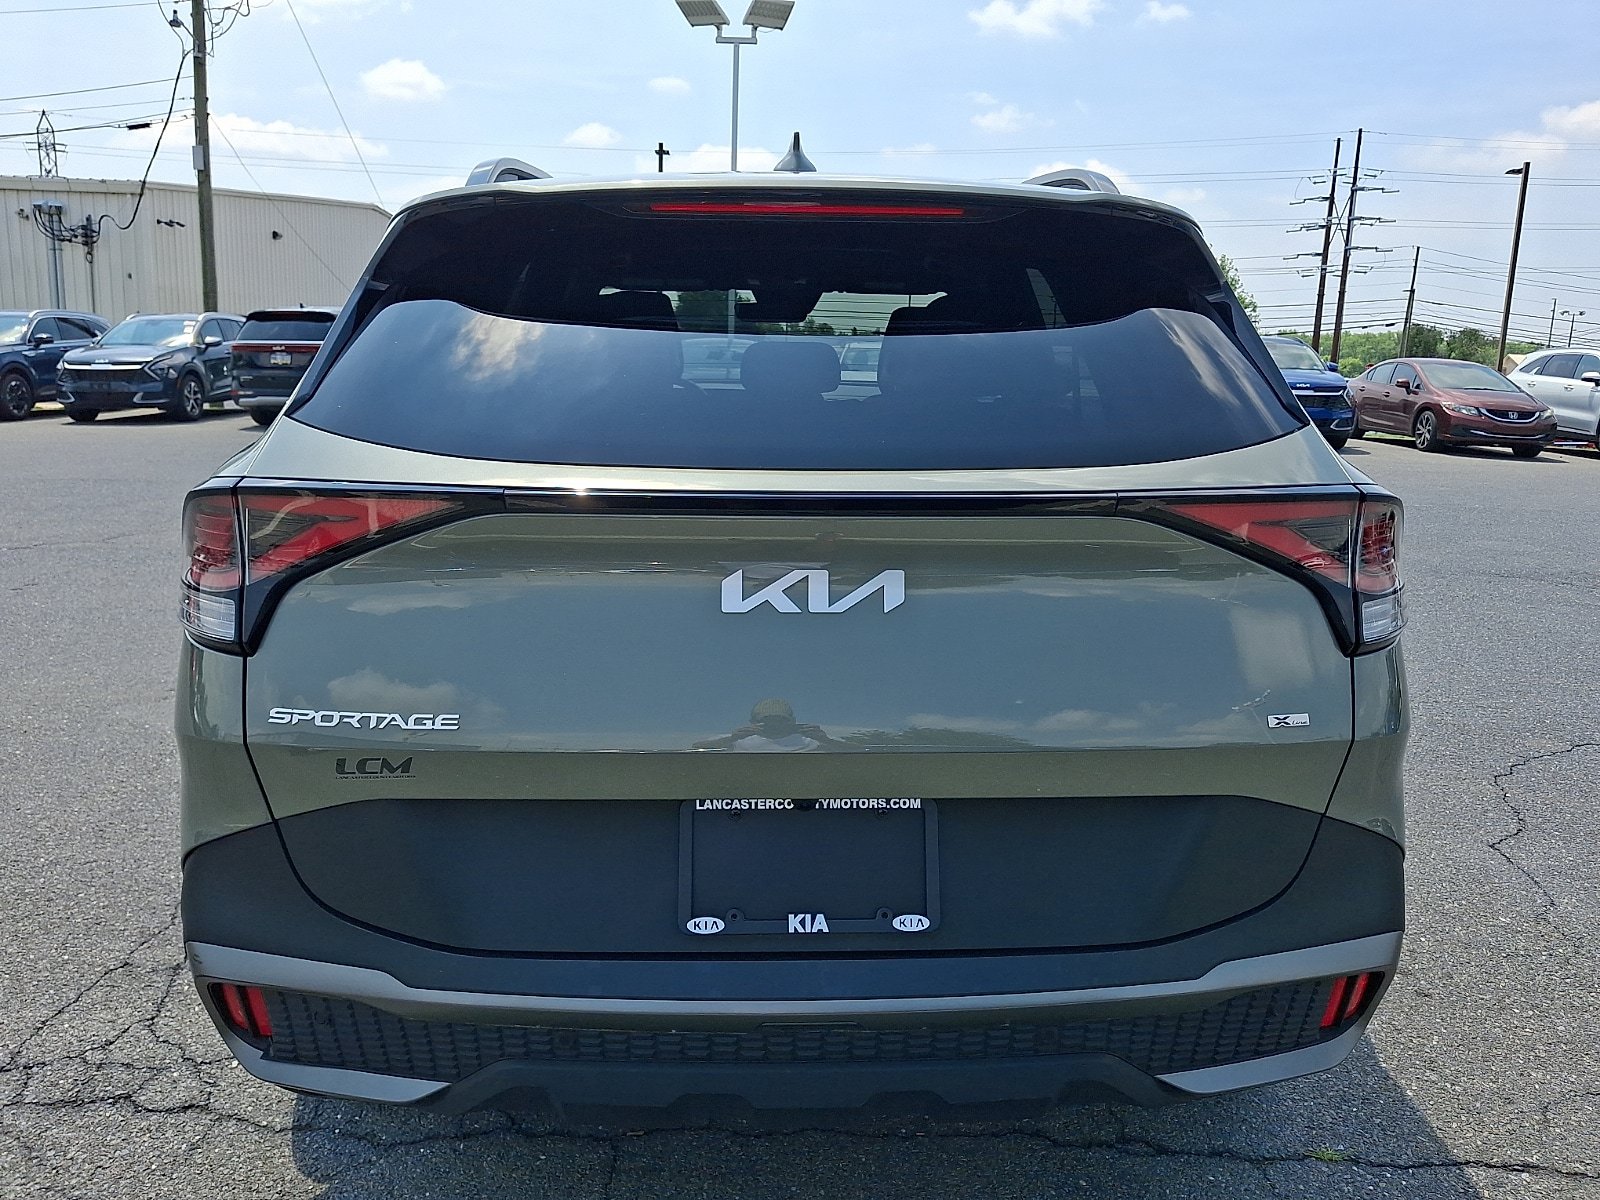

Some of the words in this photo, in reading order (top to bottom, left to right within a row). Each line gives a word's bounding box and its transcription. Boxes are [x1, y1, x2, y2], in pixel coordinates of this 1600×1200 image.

[721, 569, 905, 613] KIA
[267, 707, 460, 730] SPORTAGE
[1273, 715, 1291, 726] X
[335, 756, 413, 775] LCM
[695, 798, 921, 811] LANCASTERCOTYMOTORS.COM
[693, 920, 719, 931] KIA
[788, 913, 829, 933] KIA
[899, 918, 924, 928] KIA
